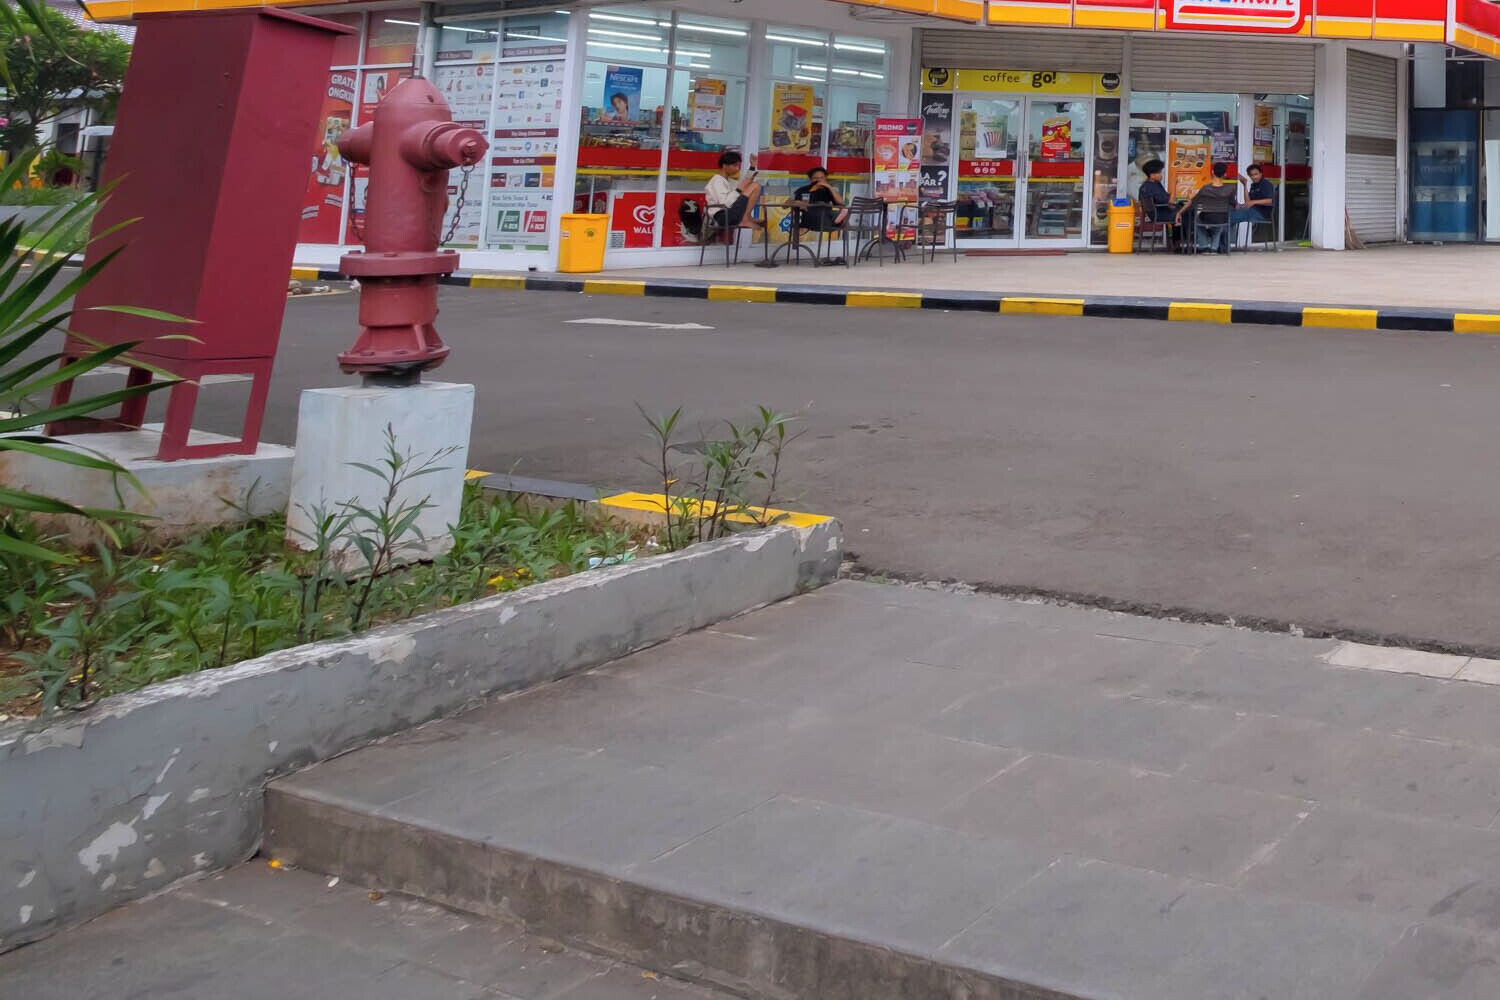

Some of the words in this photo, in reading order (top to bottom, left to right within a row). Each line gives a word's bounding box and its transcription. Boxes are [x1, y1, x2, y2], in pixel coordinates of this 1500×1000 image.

[331, 74, 357, 89] GRATI
[983, 72, 1021, 83] coffee
[1031, 71, 1057, 88] go!
